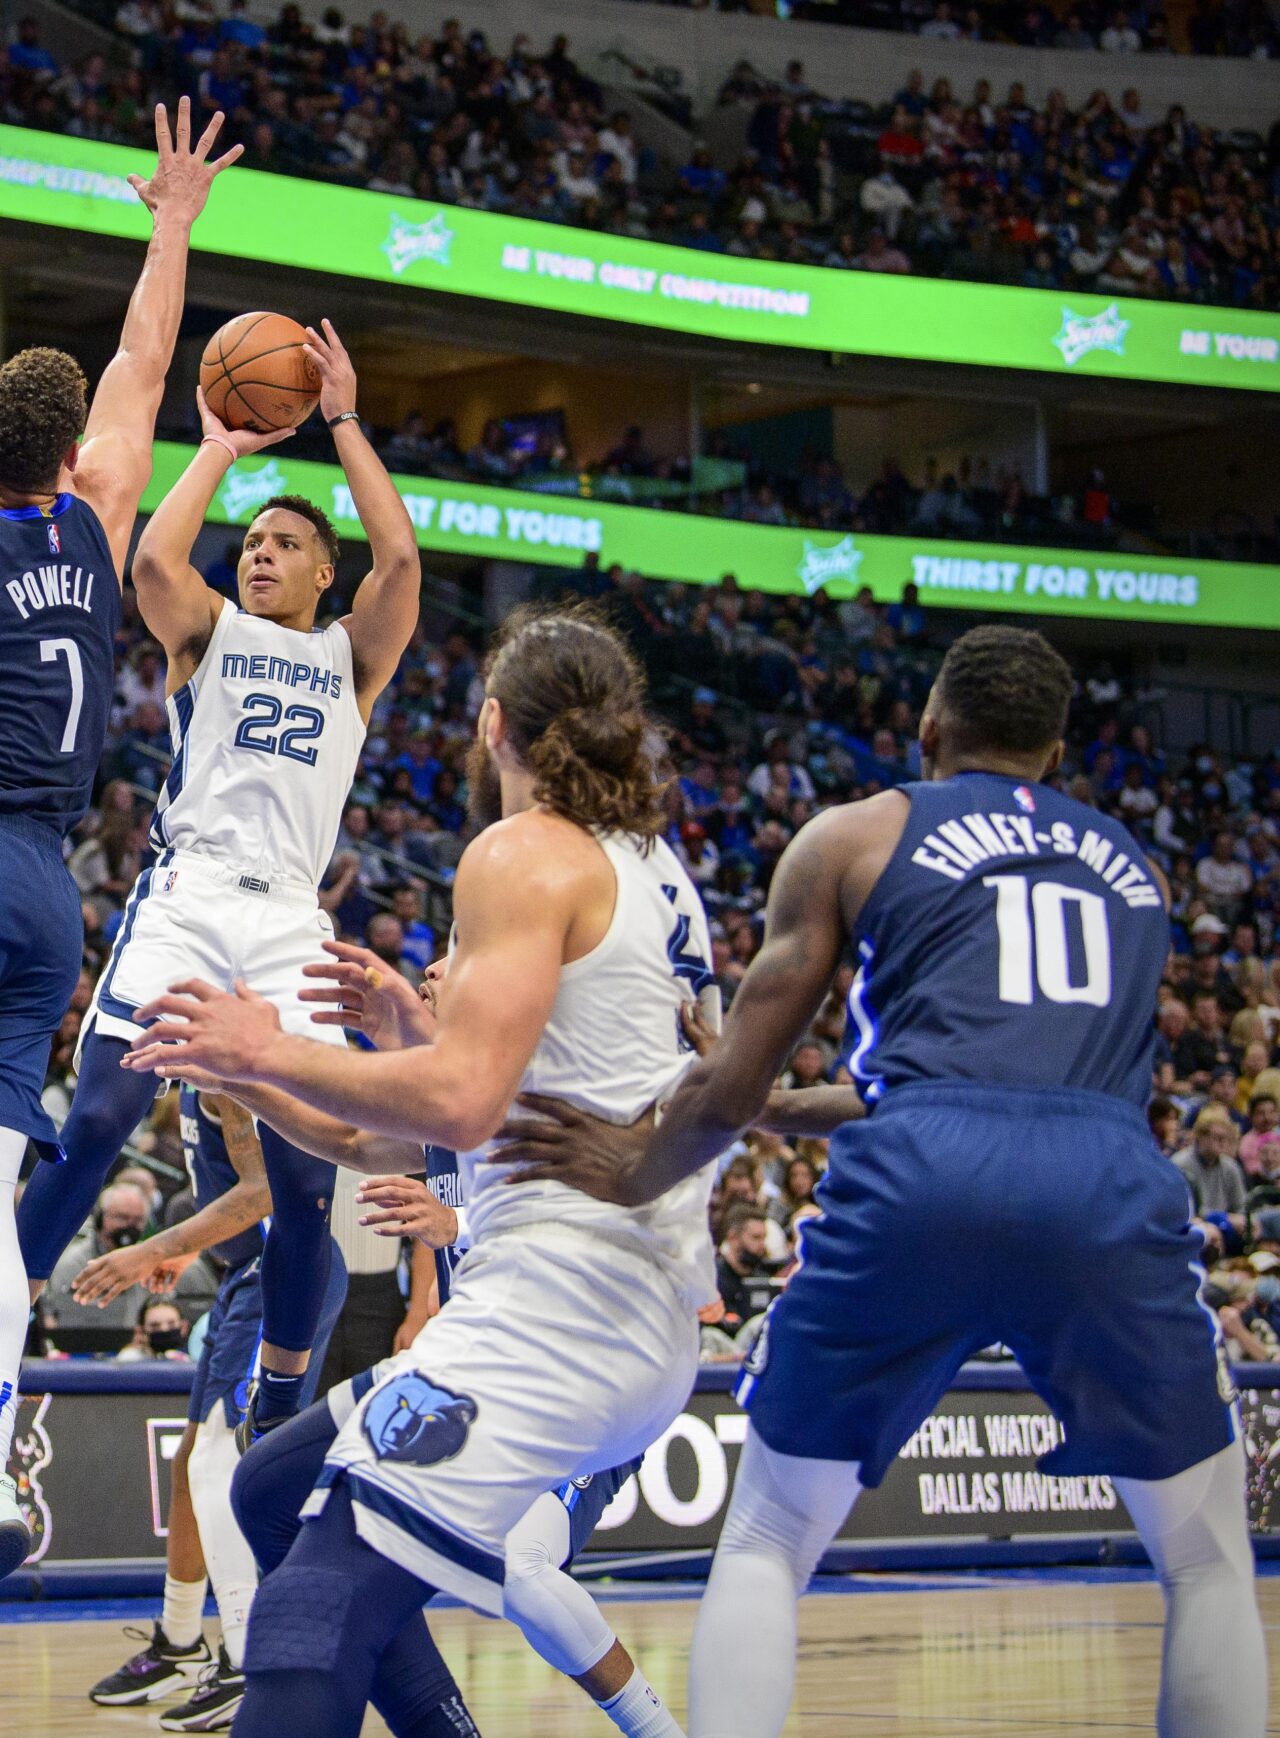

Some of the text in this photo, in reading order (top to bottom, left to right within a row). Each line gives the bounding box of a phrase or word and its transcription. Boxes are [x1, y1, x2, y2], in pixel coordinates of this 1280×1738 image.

[502, 243, 810, 317] BE YOUR ONLY COMPETITION
[1180, 328, 1279, 364] BE YOUR
[440, 498, 502, 537] FOR
[506, 507, 603, 551] YOURS
[6, 565, 94, 619] POWELL
[911, 554, 1200, 607] THIRST FOR YOURS
[40, 638, 83, 753] 7
[234, 693, 324, 767] 22
[911, 812, 1162, 908] FINNEY-SMITH
[982, 875, 1112, 1008] 10
[919, 1471, 1118, 1515] DALLAS MAVERICKS
